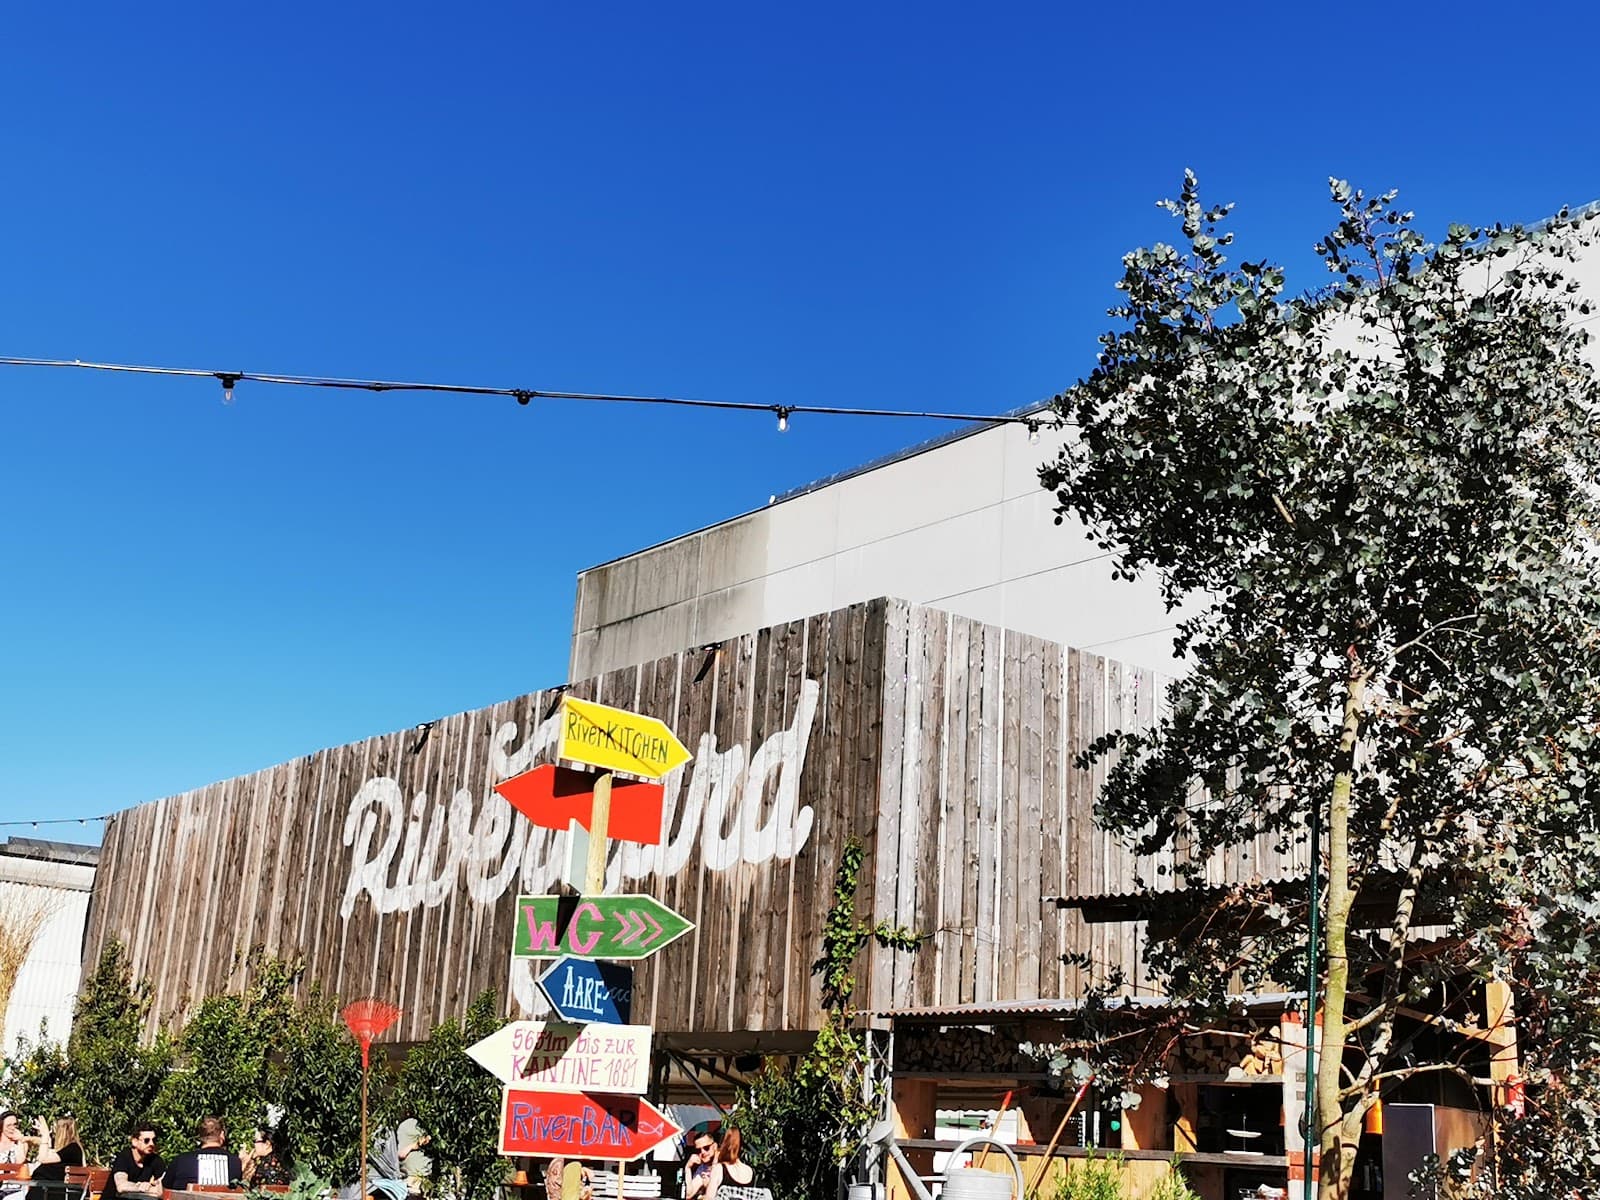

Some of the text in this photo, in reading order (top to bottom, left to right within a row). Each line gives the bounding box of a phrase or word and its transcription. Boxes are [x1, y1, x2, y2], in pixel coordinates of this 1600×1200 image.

[567, 711, 669, 763] RiverKITCHEN
[521, 903, 604, 954] WC
[576, 1031, 600, 1055] bis
[511, 1055, 639, 1088] KANTINE 1881
[511, 1101, 633, 1146] RiverBAR
